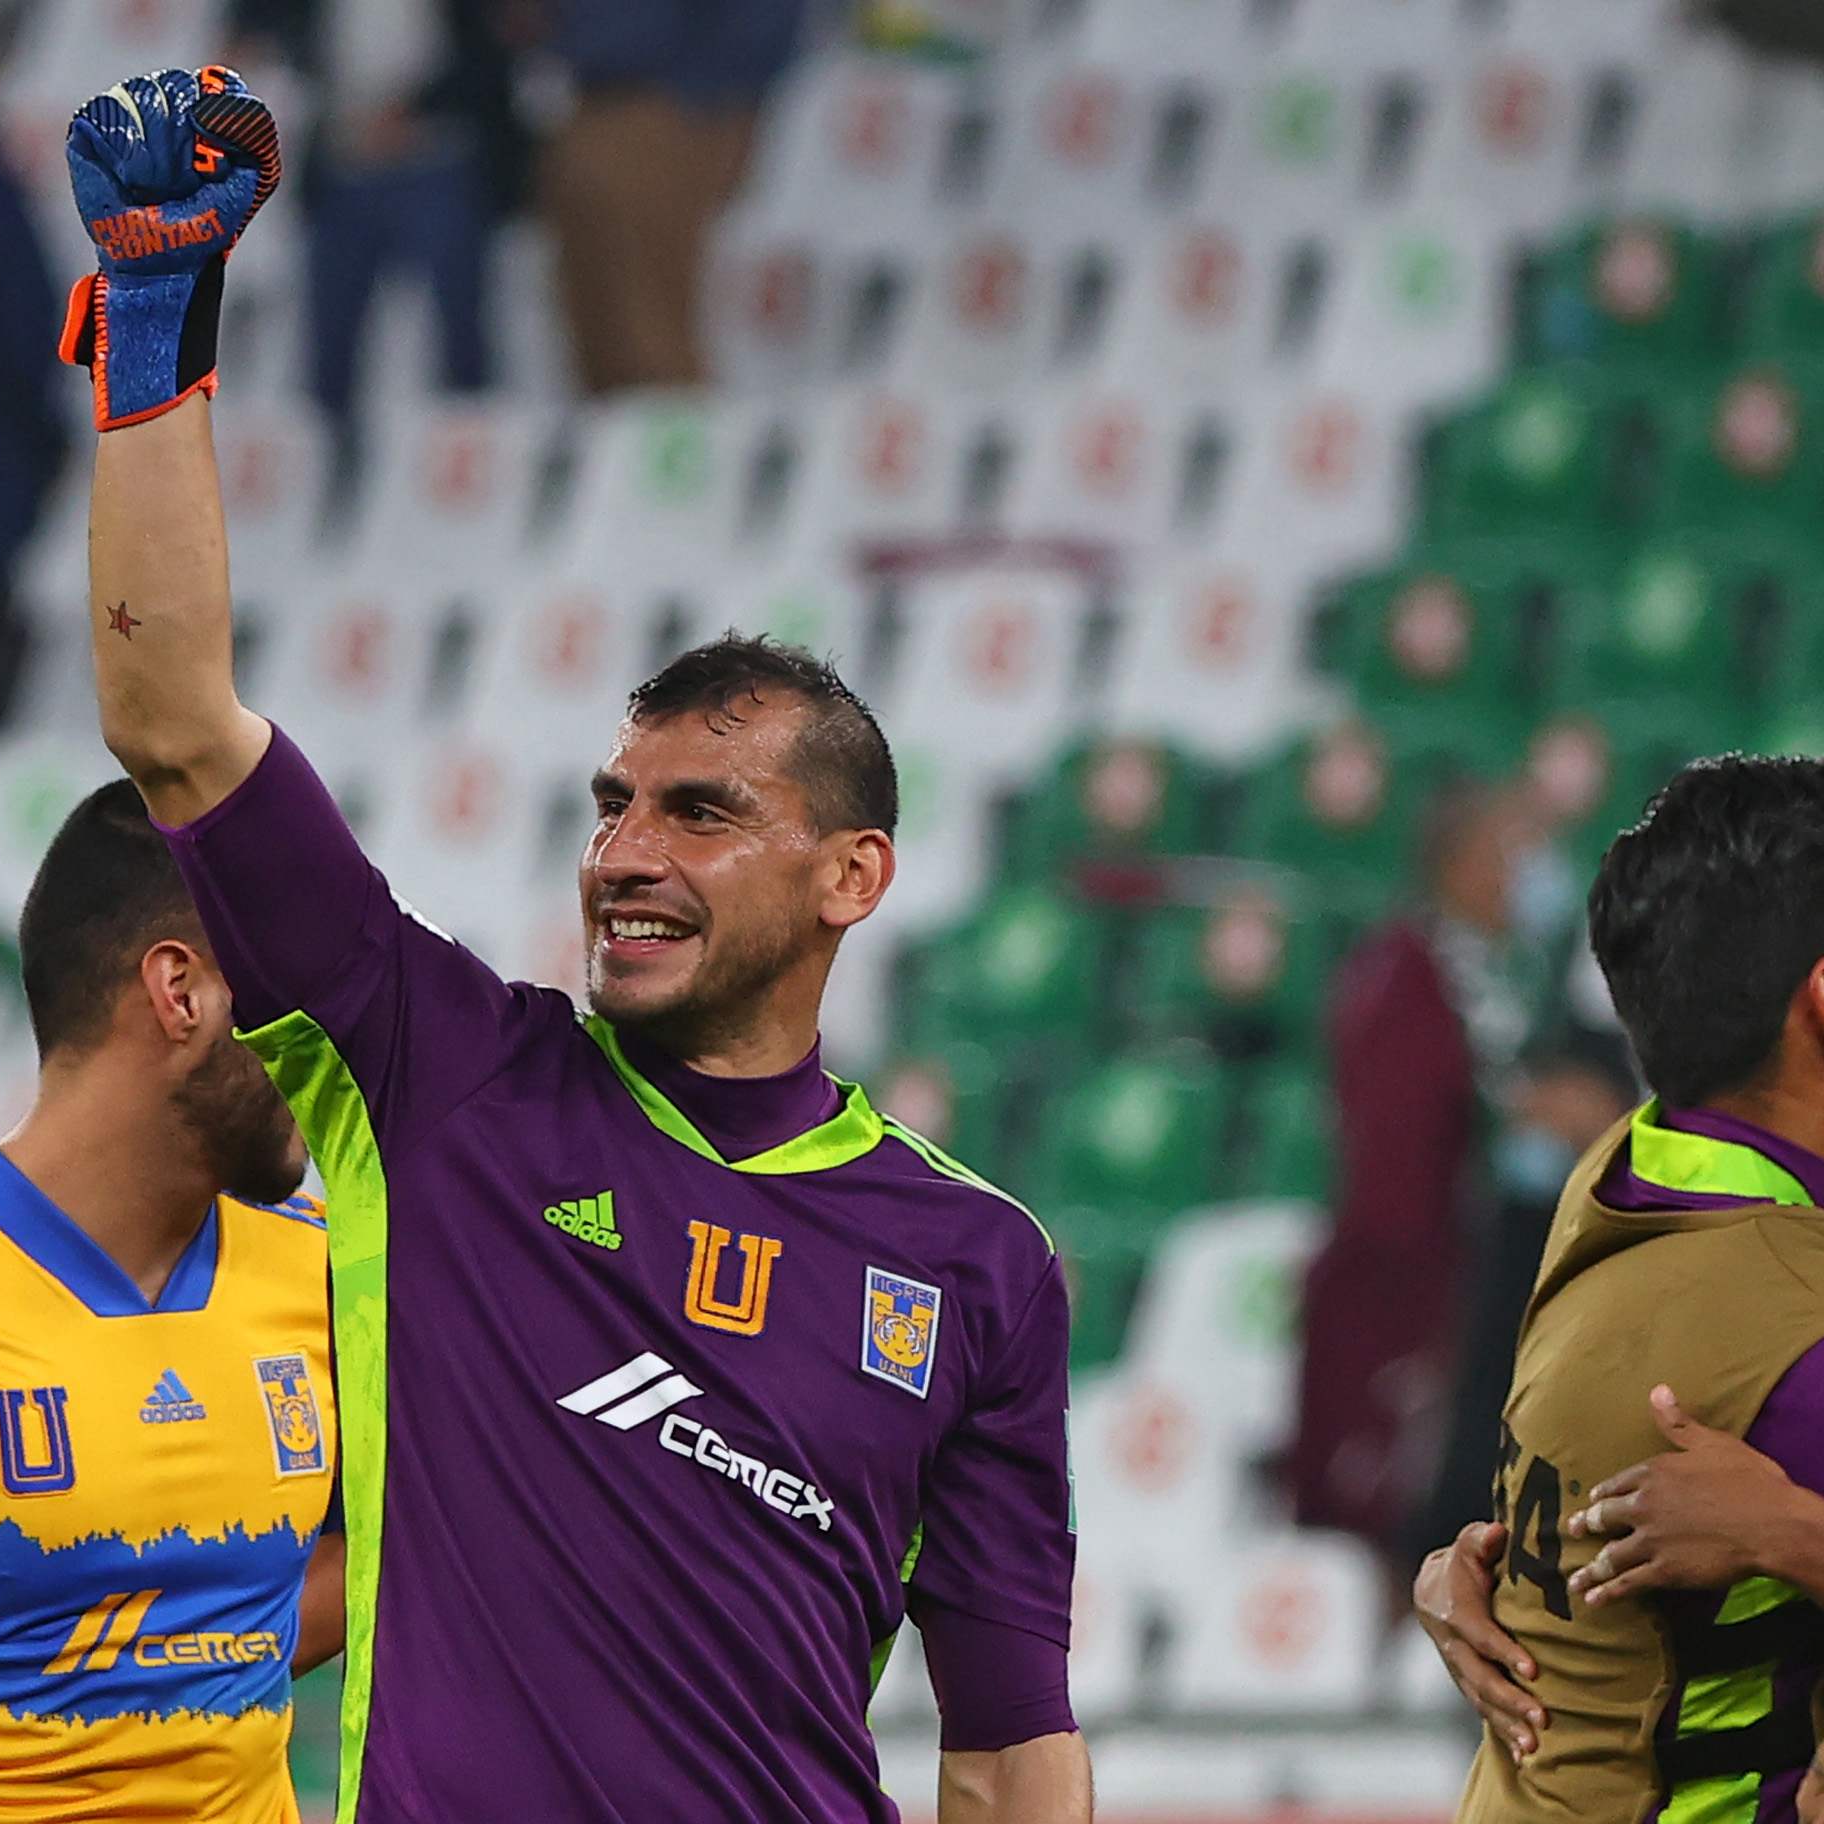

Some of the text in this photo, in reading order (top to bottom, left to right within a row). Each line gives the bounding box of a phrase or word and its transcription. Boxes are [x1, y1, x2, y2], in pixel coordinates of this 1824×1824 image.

[106, 208, 225, 261] CONTACT
[544, 1205, 622, 1251] adidas
[685, 1220, 782, 1336] U
[872, 1275, 936, 1309] TIGRES
[879, 1358, 914, 1384] UANL
[139, 1402, 207, 1424] adidas
[659, 1413, 835, 1532] CEMEX
